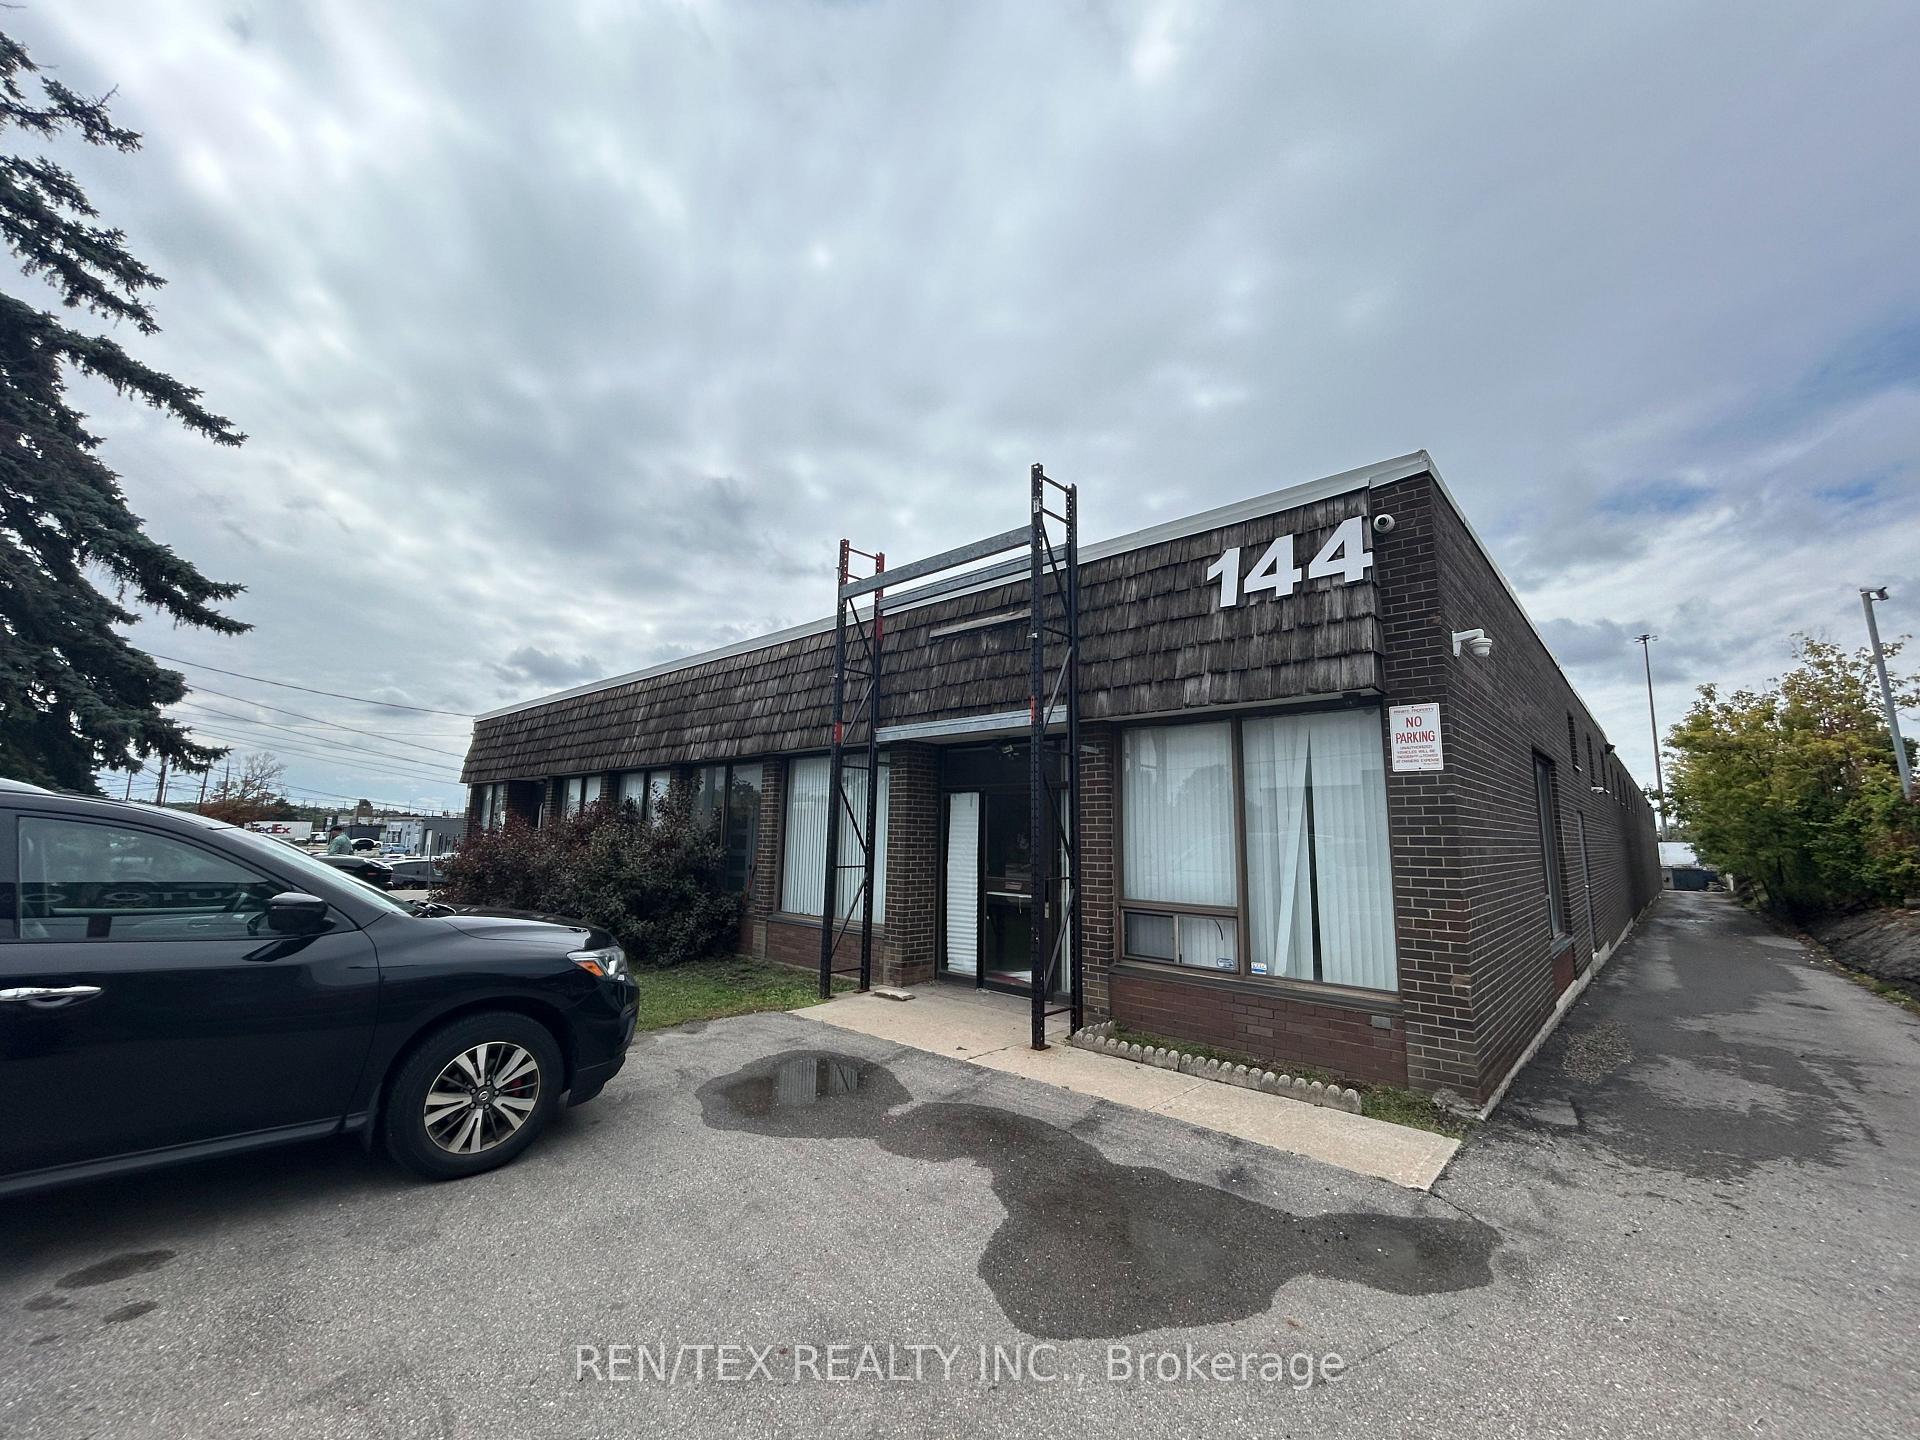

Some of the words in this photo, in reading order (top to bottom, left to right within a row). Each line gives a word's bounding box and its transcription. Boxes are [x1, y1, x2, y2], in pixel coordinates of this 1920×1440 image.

[1206, 515, 1373, 608] 144
[1405, 716, 1422, 728] NO
[1395, 730, 1435, 744] PARKING
